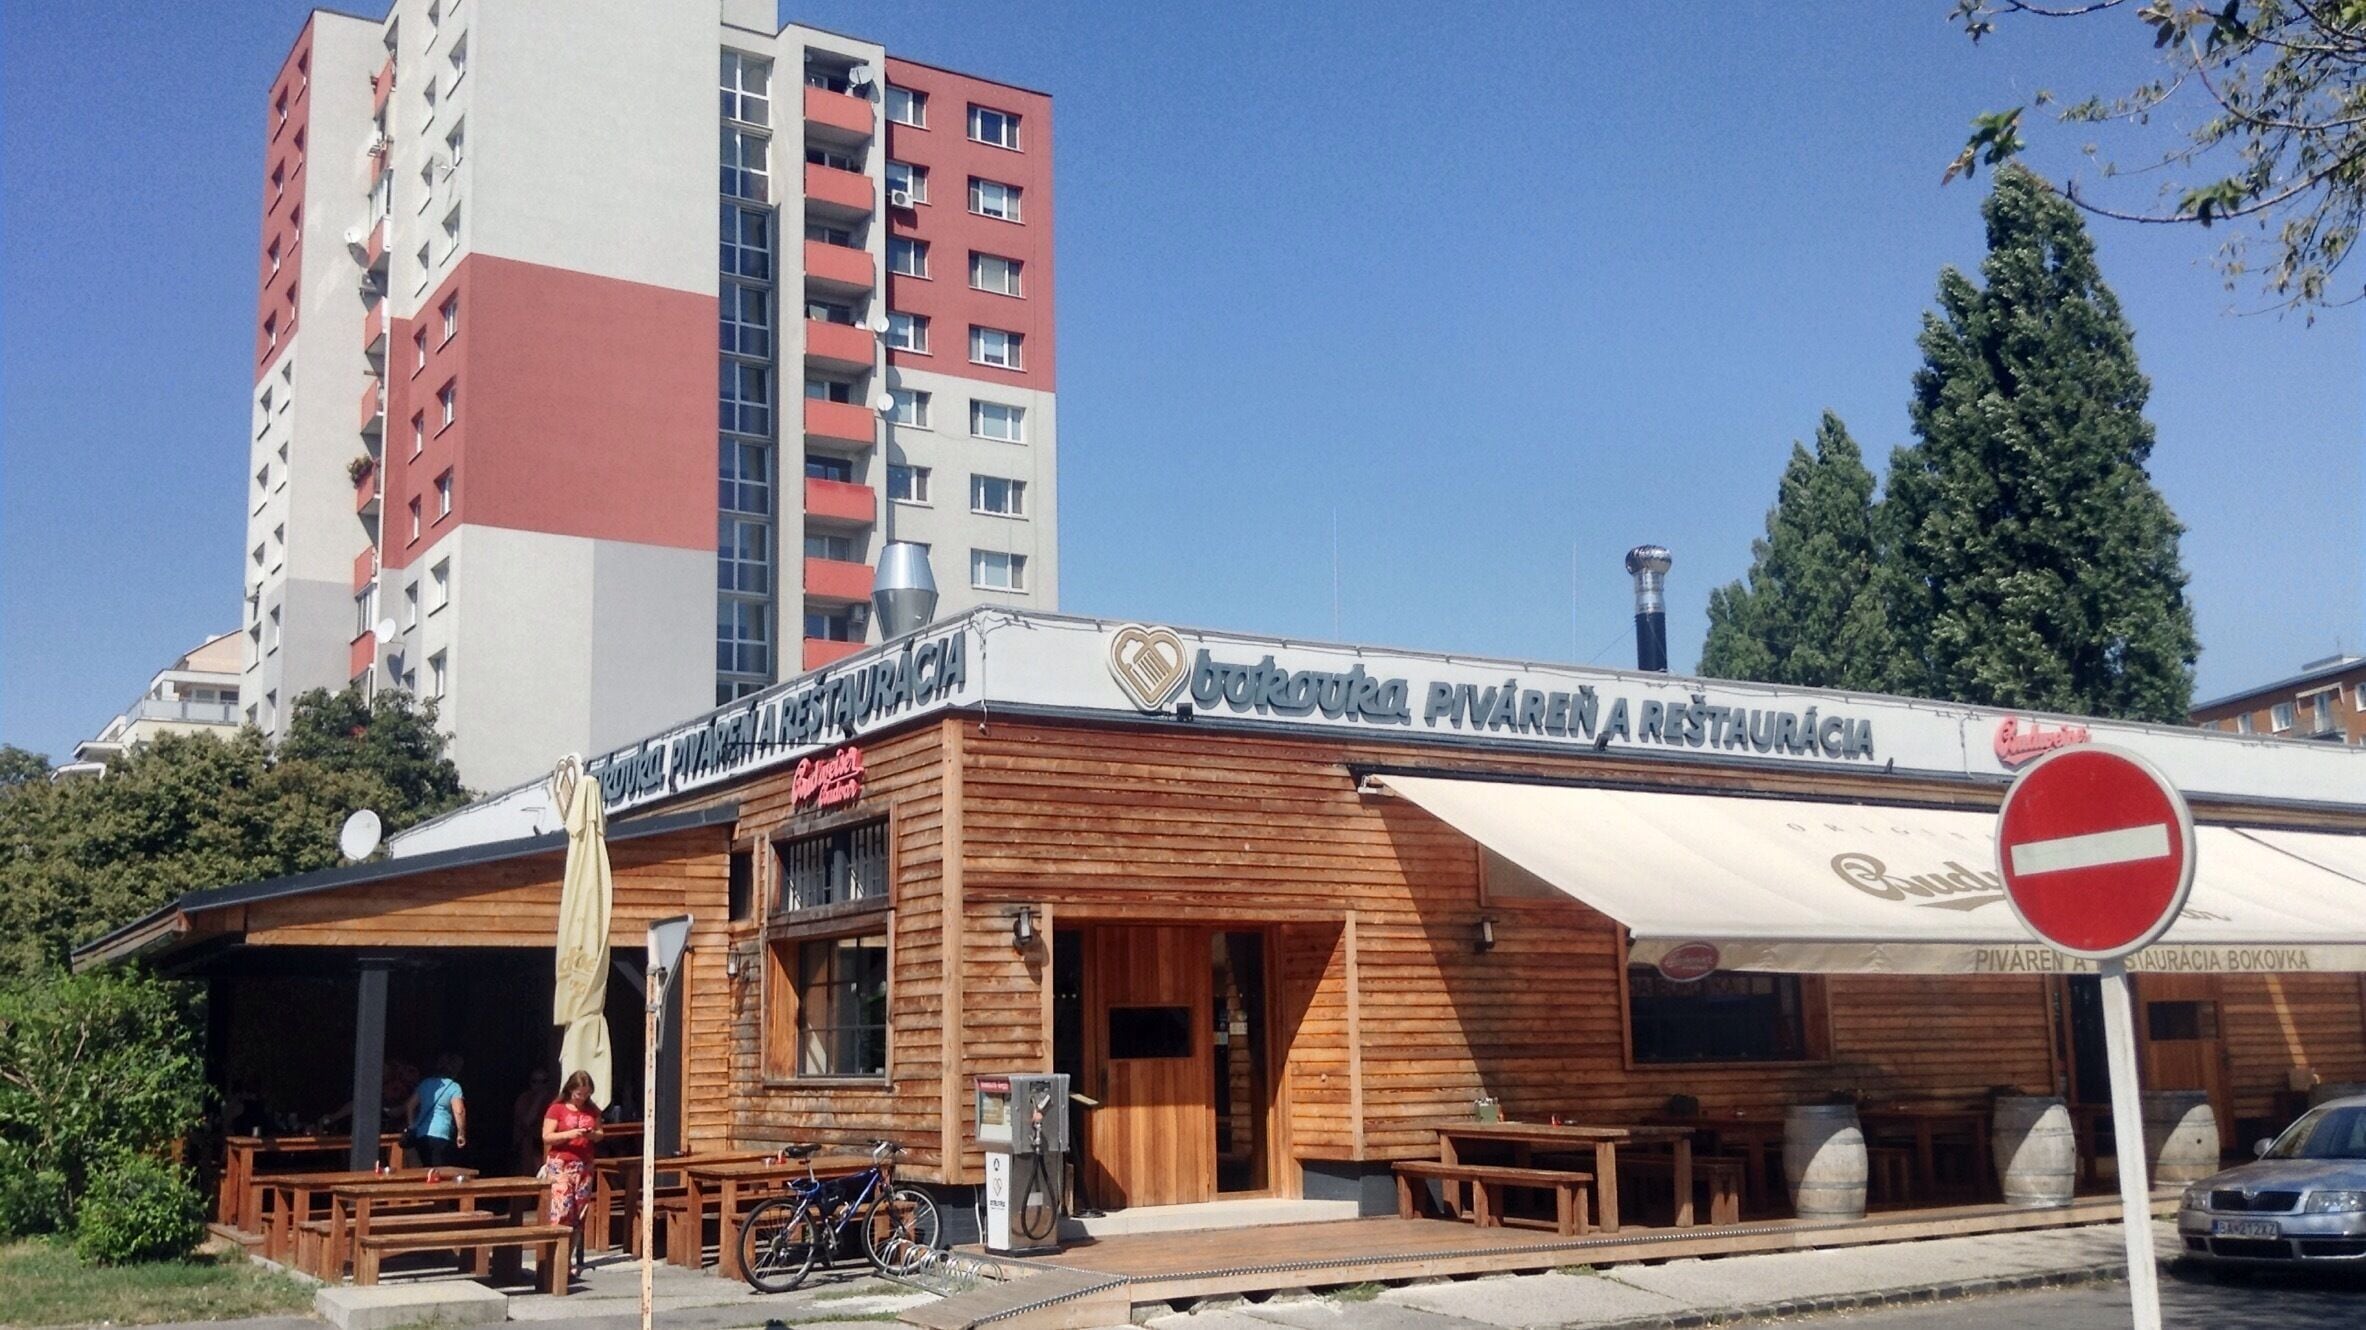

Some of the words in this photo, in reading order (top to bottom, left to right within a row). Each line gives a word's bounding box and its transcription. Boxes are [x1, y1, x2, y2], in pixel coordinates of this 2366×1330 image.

[760, 703, 776, 759] A
[777, 629, 967, 752] REŠTAURÁCIA
[1424, 678, 1599, 739] PIVÁREŇ
[1602, 697, 1631, 742] A
[1638, 694, 1875, 760] REŠTAURÁCIA
[1786, 823, 1997, 842] ORIGIN
[2227, 948, 2310, 971] BOKOVKA
